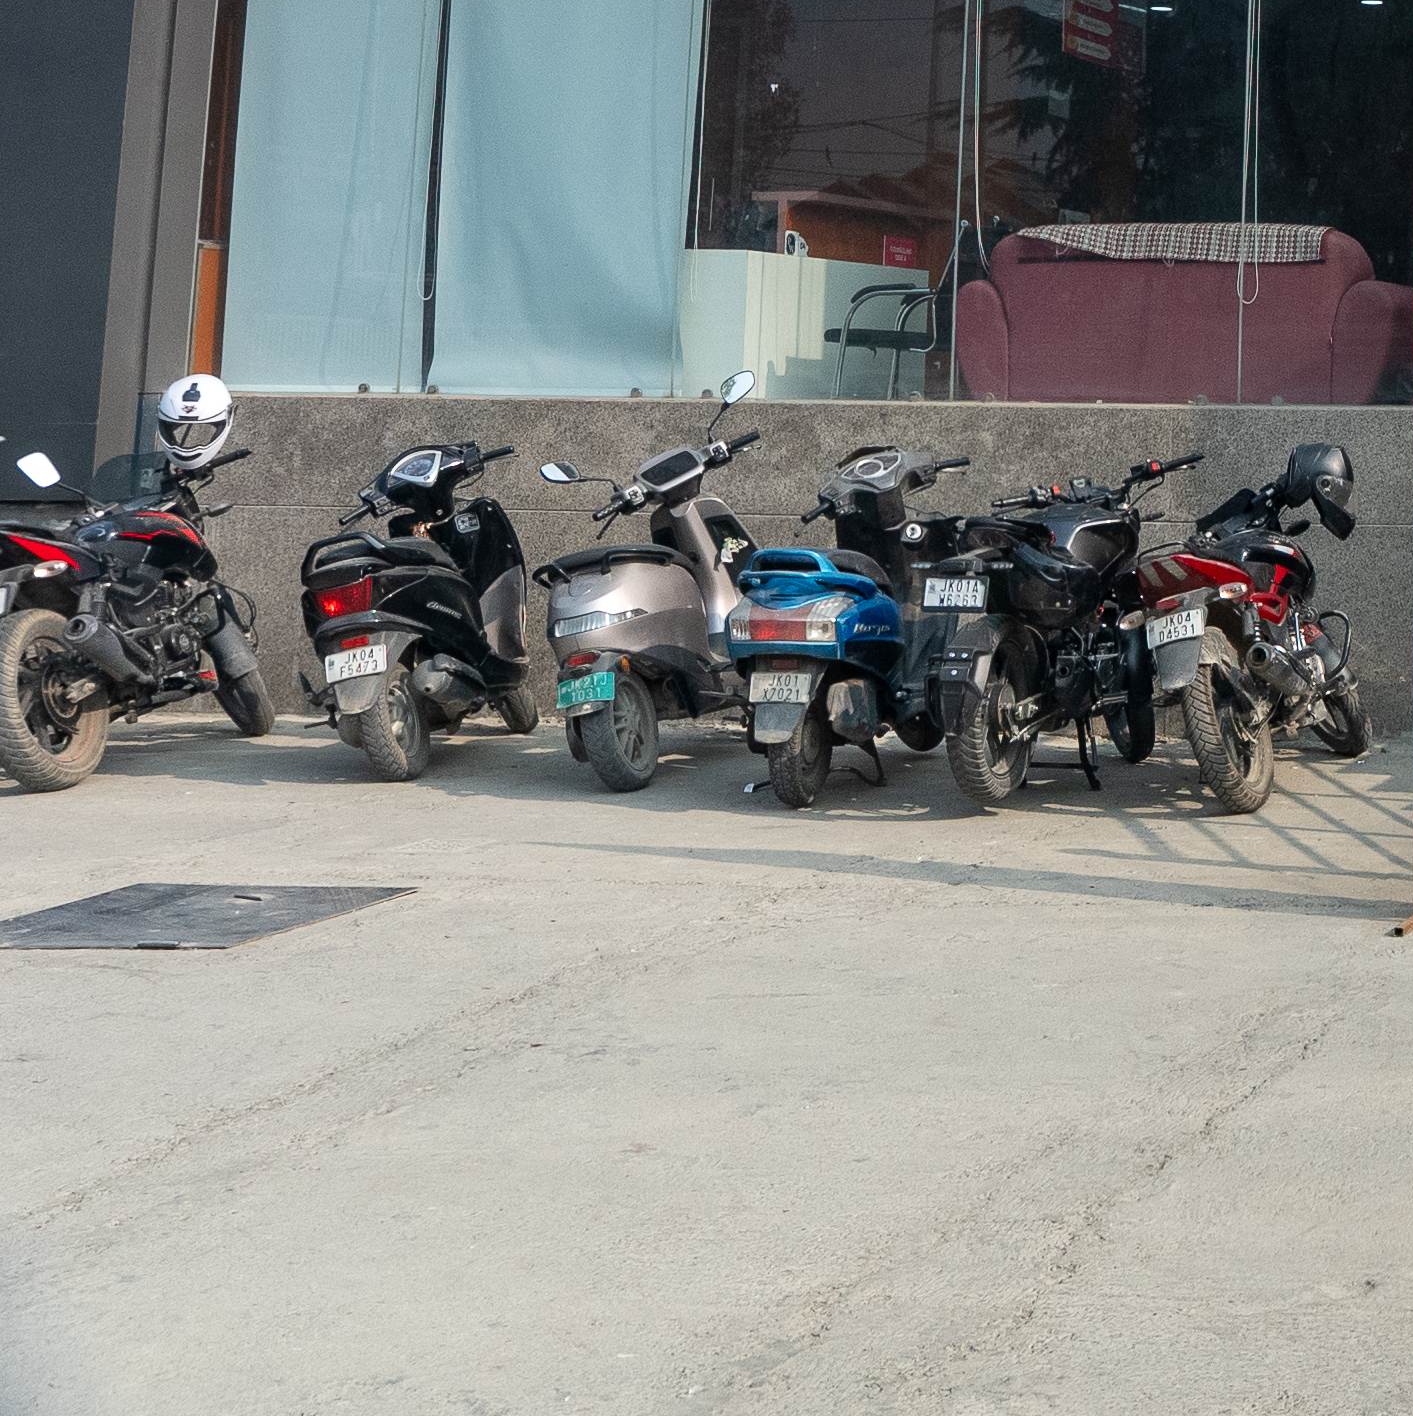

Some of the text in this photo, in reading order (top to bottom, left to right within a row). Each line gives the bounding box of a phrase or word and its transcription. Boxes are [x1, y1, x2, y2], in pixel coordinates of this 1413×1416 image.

[940, 579, 979, 593] JK01A
[1162, 611, 1191, 629] JK04
[344, 648, 374, 665] JK04
[768, 674, 799, 687] JK01
[571, 687, 601, 702] 1031
[762, 687, 800, 702] X7021
